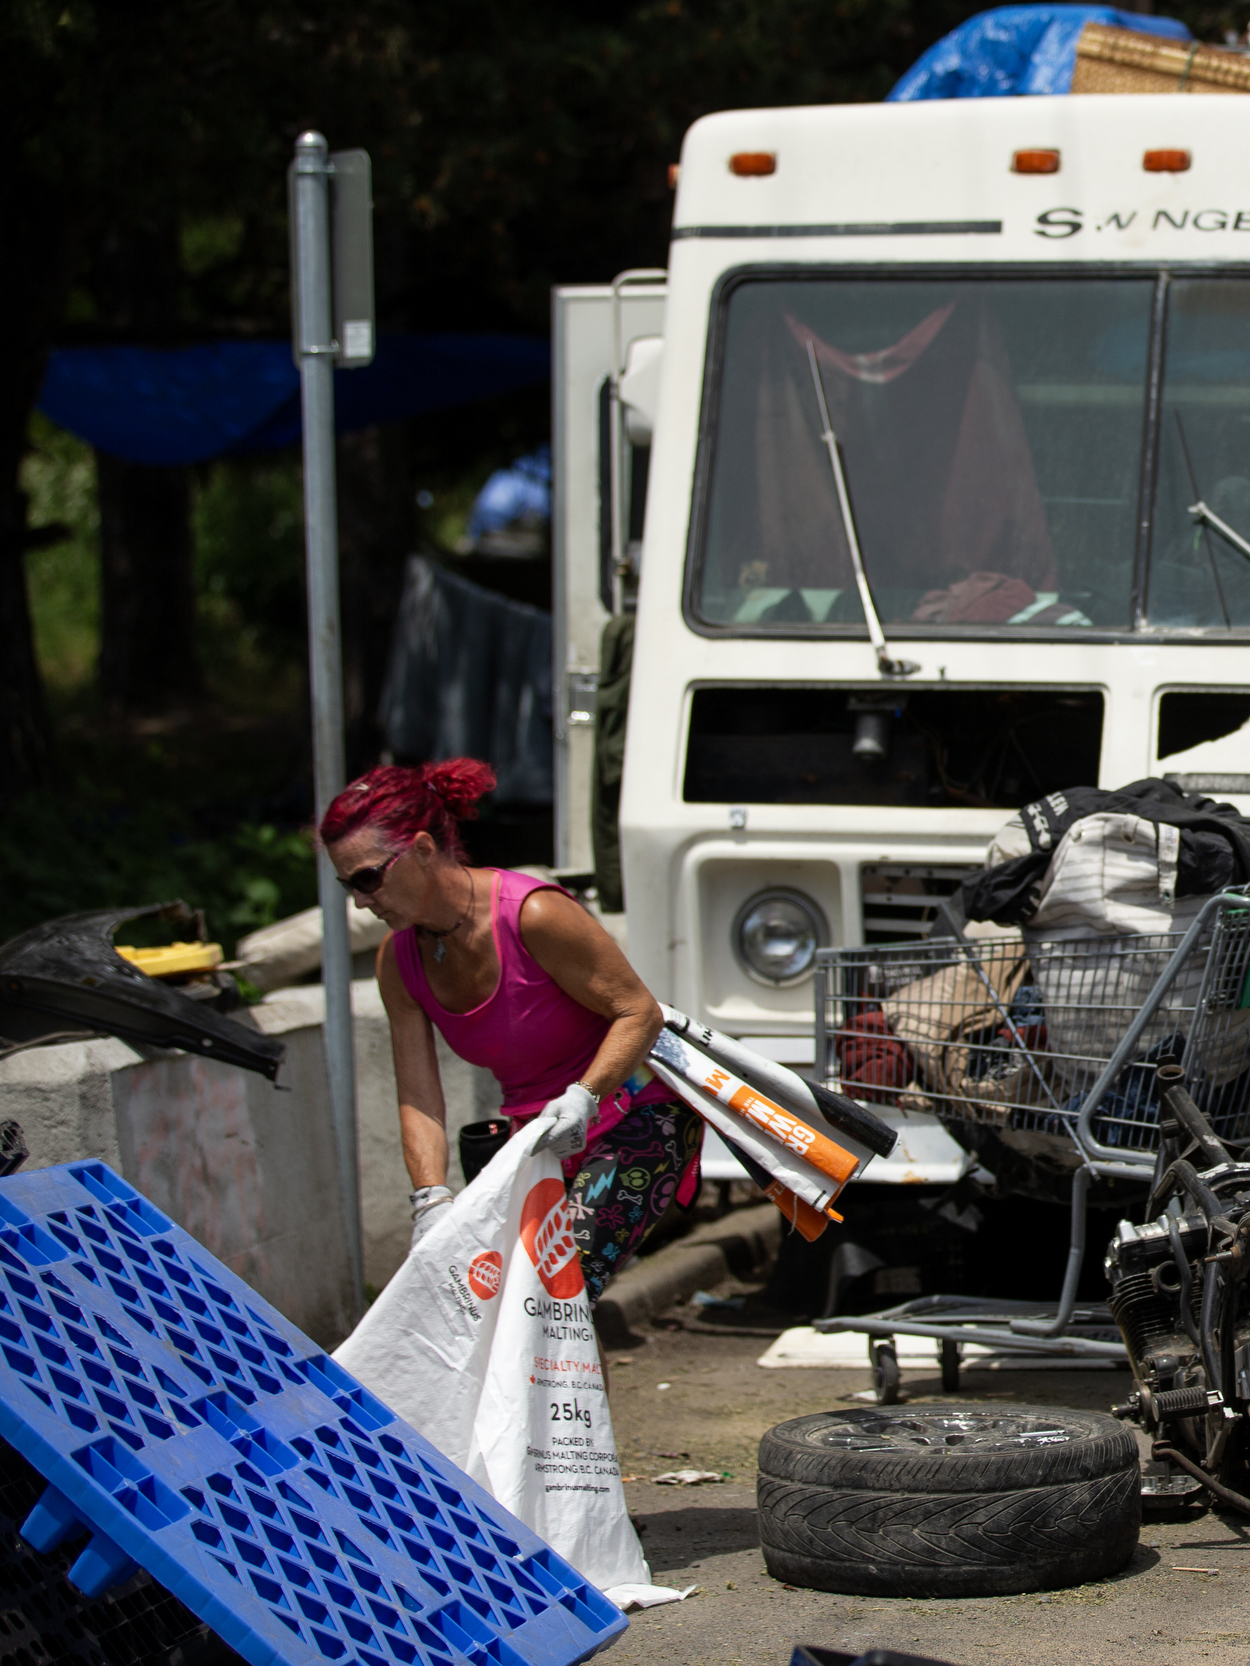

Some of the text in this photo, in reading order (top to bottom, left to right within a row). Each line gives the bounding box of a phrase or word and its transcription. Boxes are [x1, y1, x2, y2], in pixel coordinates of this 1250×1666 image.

[448, 1282, 468, 1316] MALTING
[449, 1265, 482, 1321] GAMBRINUS
[542, 1325, 590, 1341] MALTING
[534, 1356, 580, 1372] SPECIALTY
[550, 1397, 592, 1429] 25kg
[552, 1437, 584, 1447] PACKED
[552, 1450, 588, 1461] MALTING
[545, 1483, 611, 1494] gambrinusmalting.com
